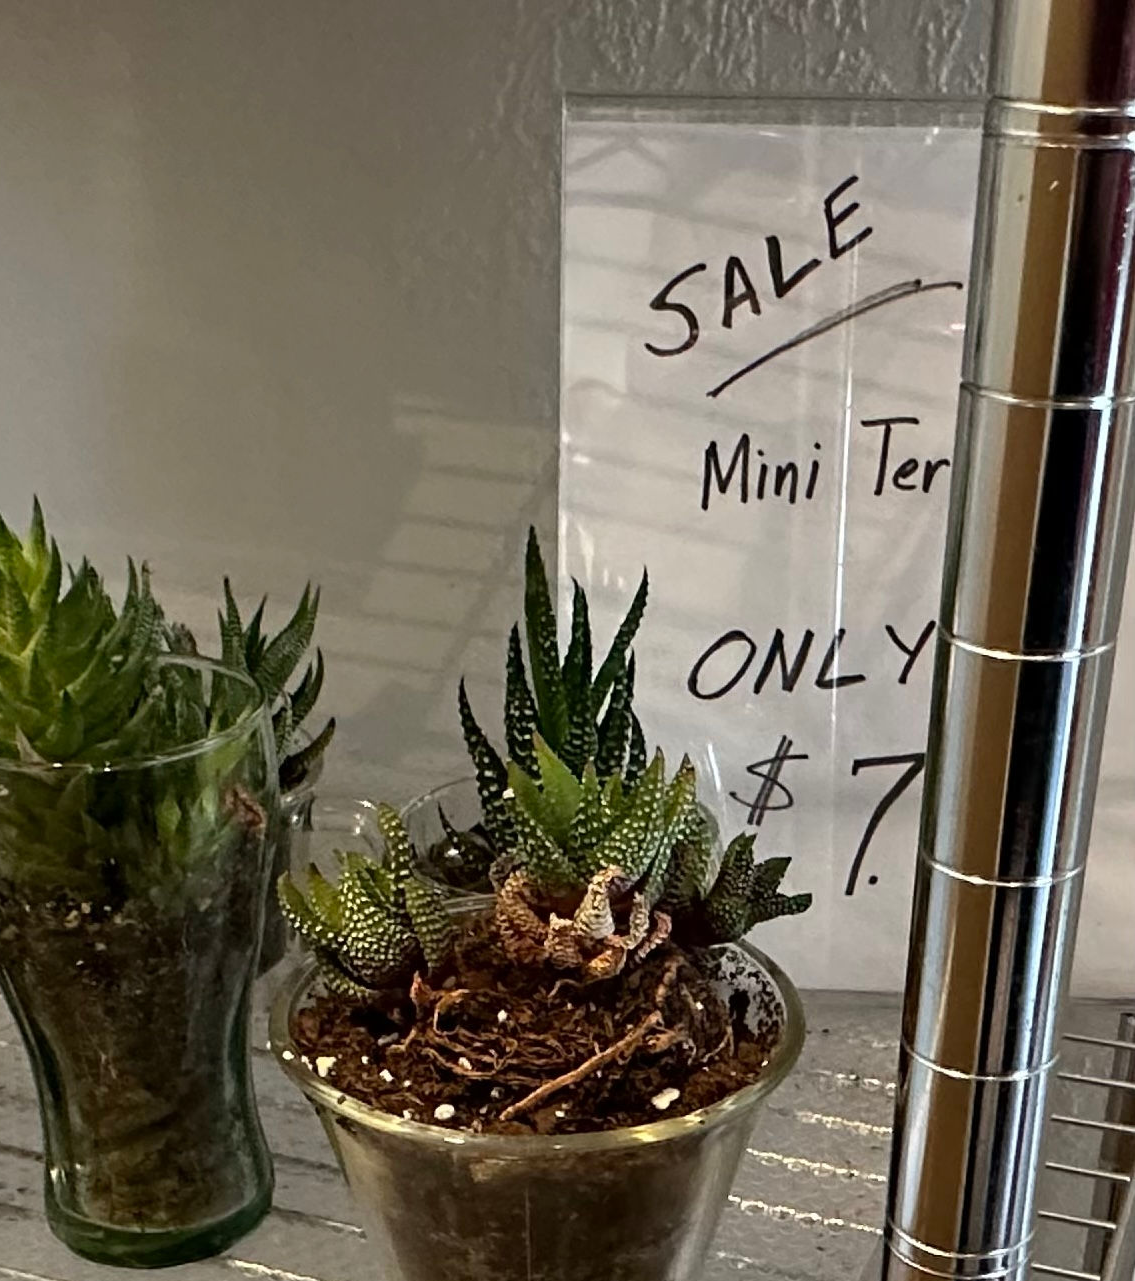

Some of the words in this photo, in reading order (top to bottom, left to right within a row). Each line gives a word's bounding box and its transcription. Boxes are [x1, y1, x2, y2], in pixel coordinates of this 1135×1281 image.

[644, 174, 874, 357] SALE
[701, 432, 822, 511] Mini
[686, 620, 938, 703] ONLY
[729, 734, 810, 826] $
